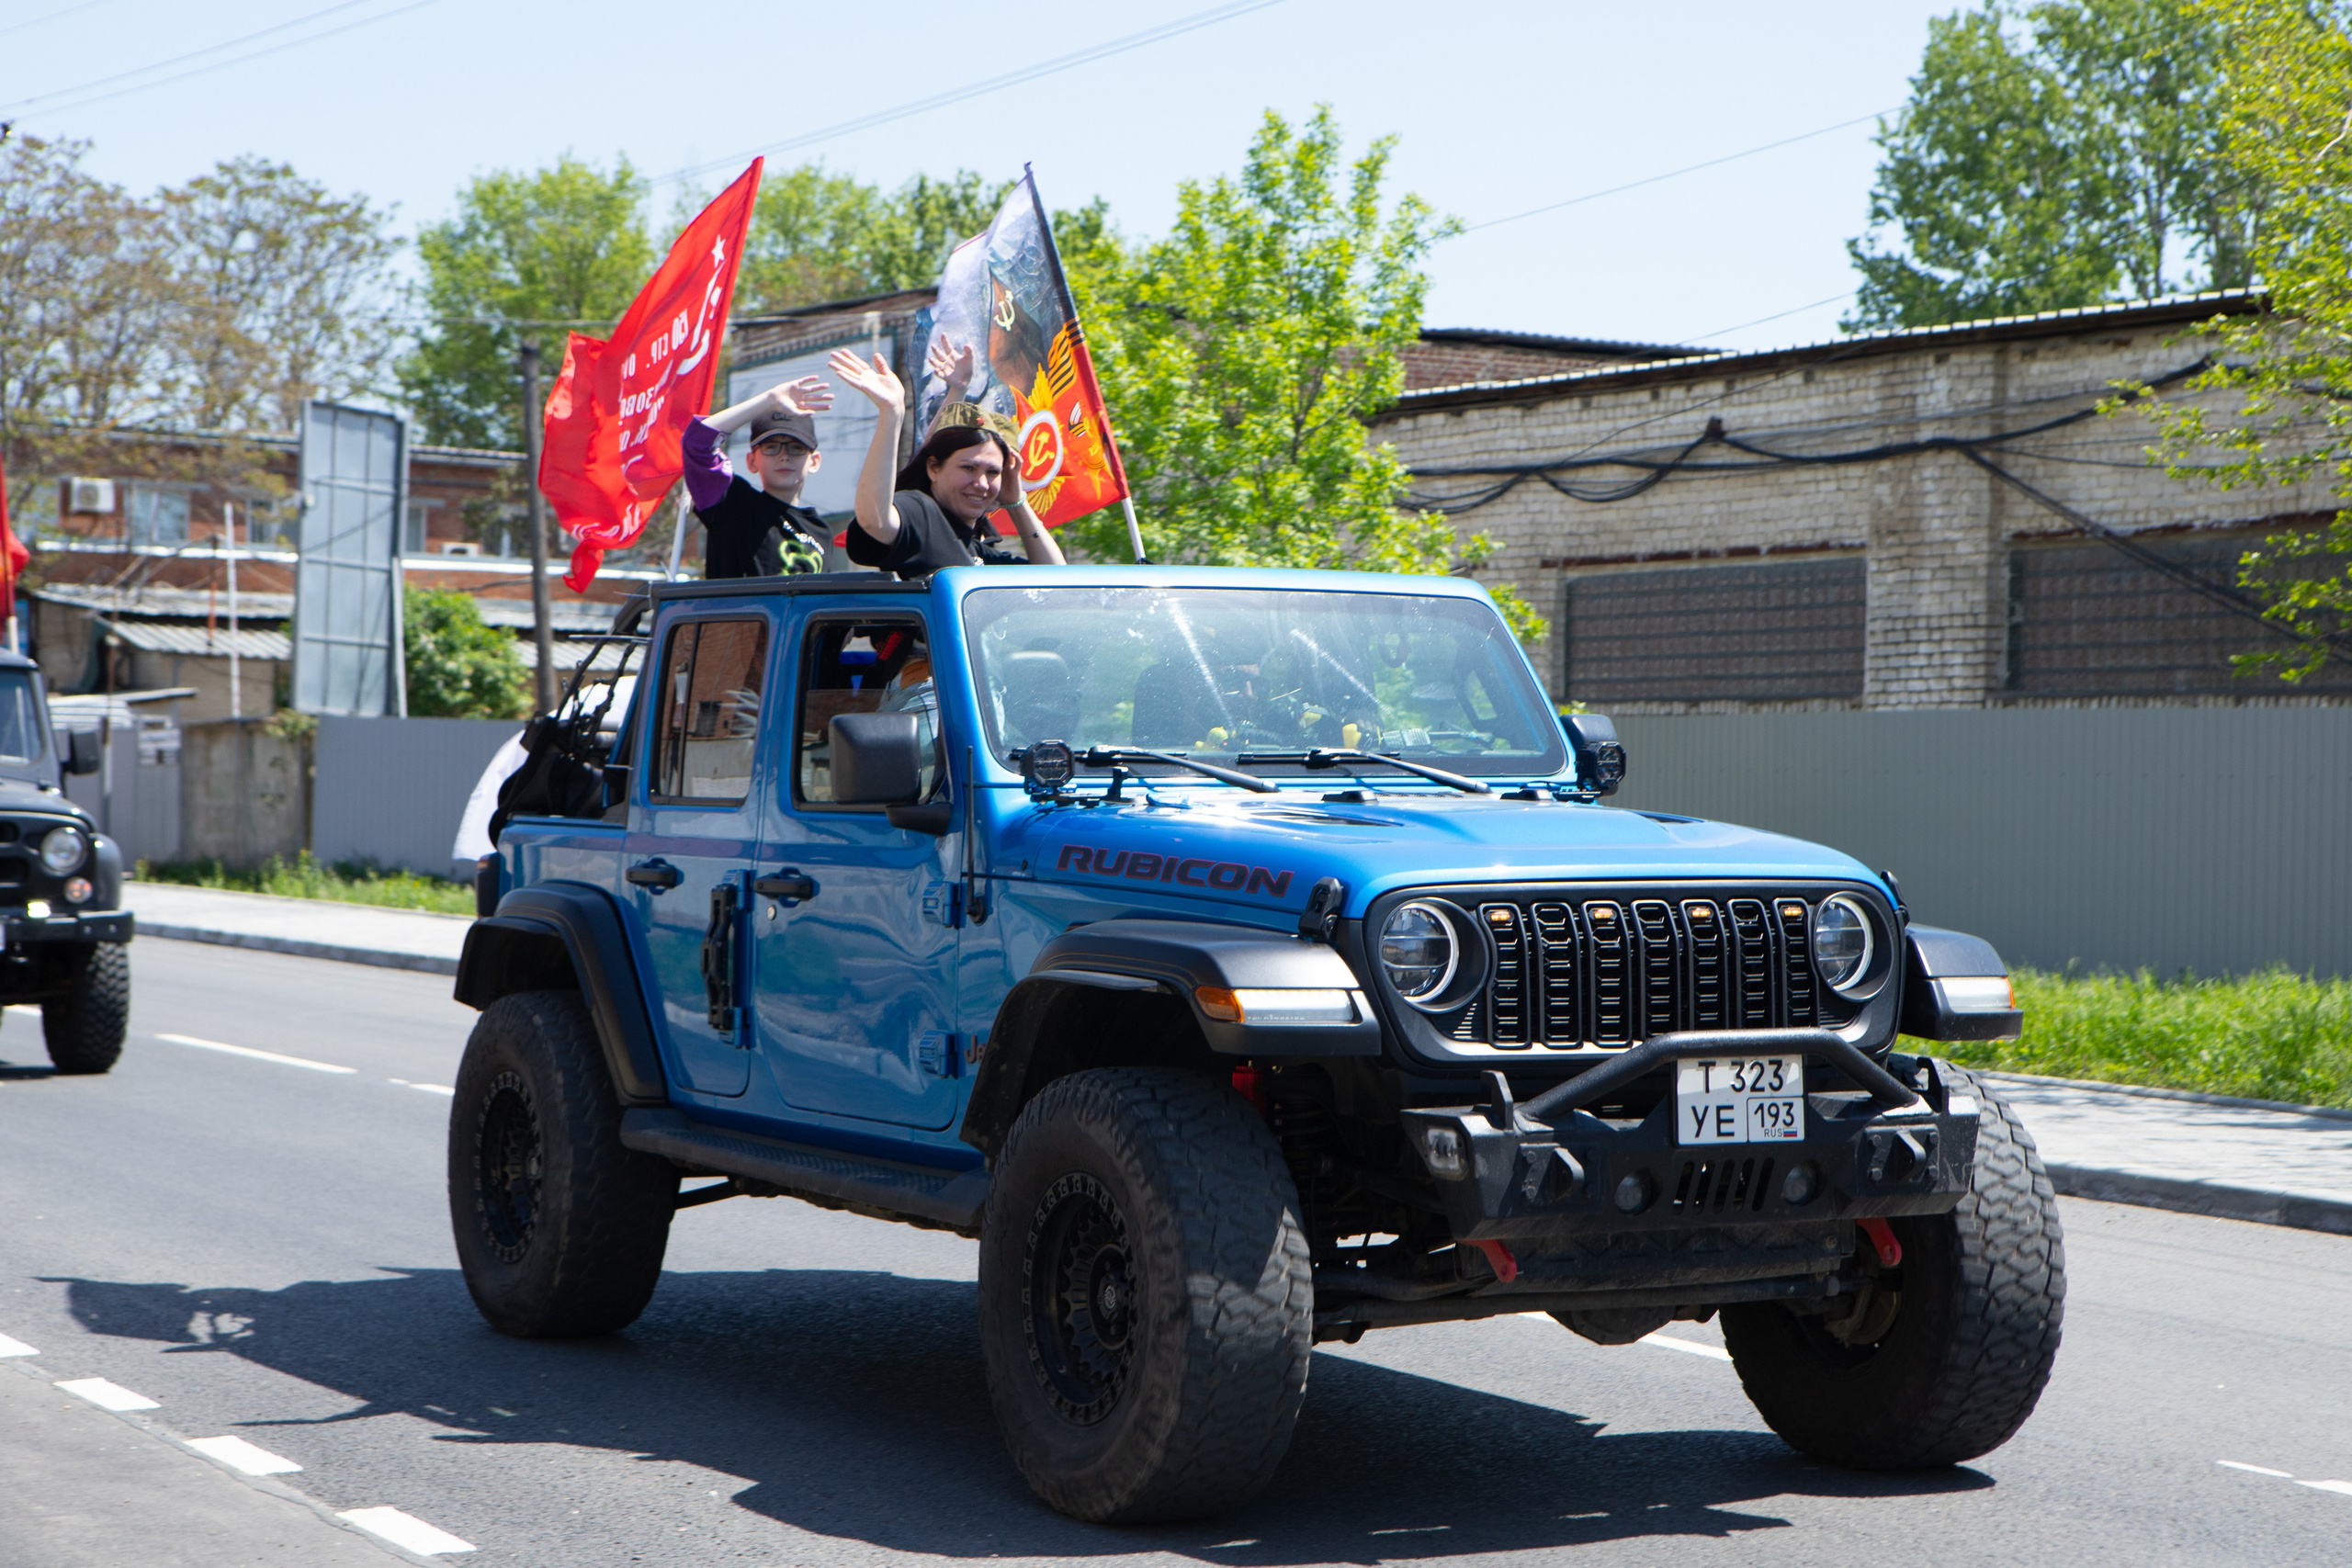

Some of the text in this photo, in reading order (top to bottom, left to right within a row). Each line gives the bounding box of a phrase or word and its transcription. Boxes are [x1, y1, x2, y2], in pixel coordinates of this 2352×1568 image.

[1057, 844, 1295, 897] RUBICON
[1698, 1060, 1783, 1093] Т 323
[1754, 1102, 1793, 1128] 193
[1764, 1128, 1782, 1138] RUS
